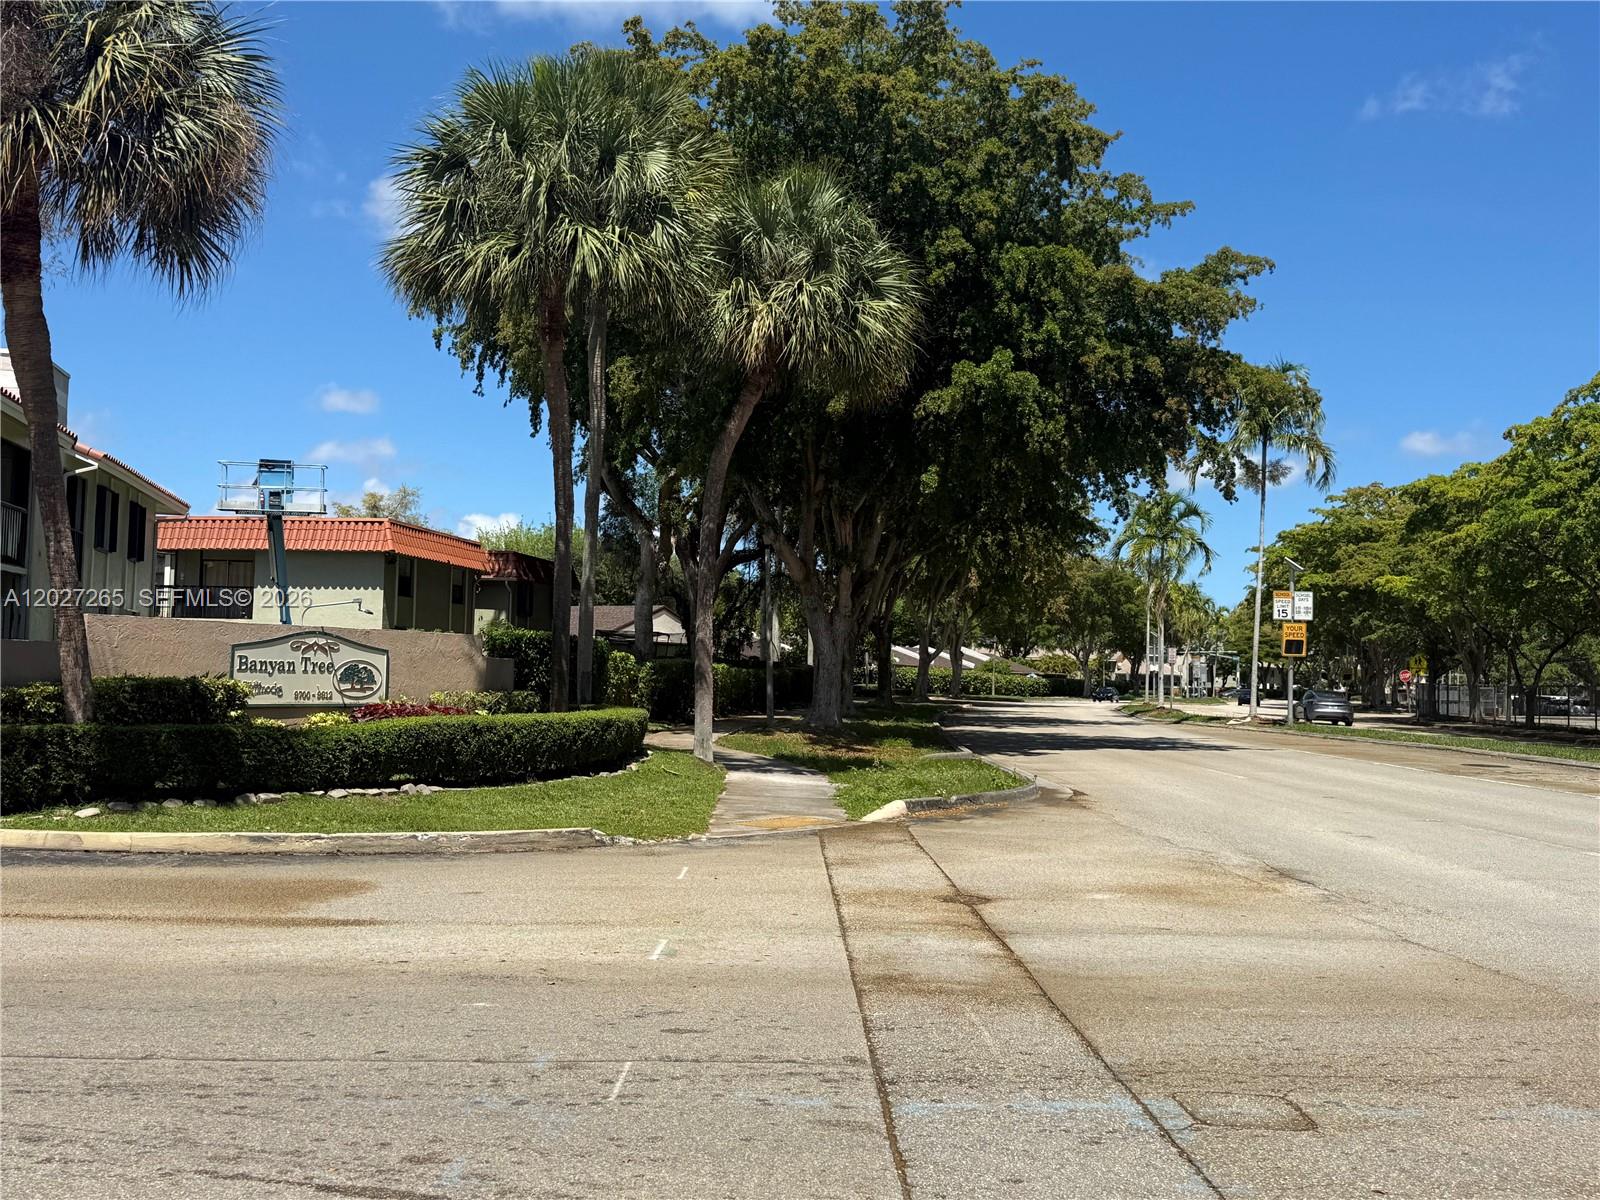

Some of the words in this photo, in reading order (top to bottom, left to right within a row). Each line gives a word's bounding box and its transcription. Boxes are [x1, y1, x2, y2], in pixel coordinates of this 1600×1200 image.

[1277, 609, 1288, 618] 15
[236, 654, 296, 677] Banyan
[300, 656, 334, 674] Tree
